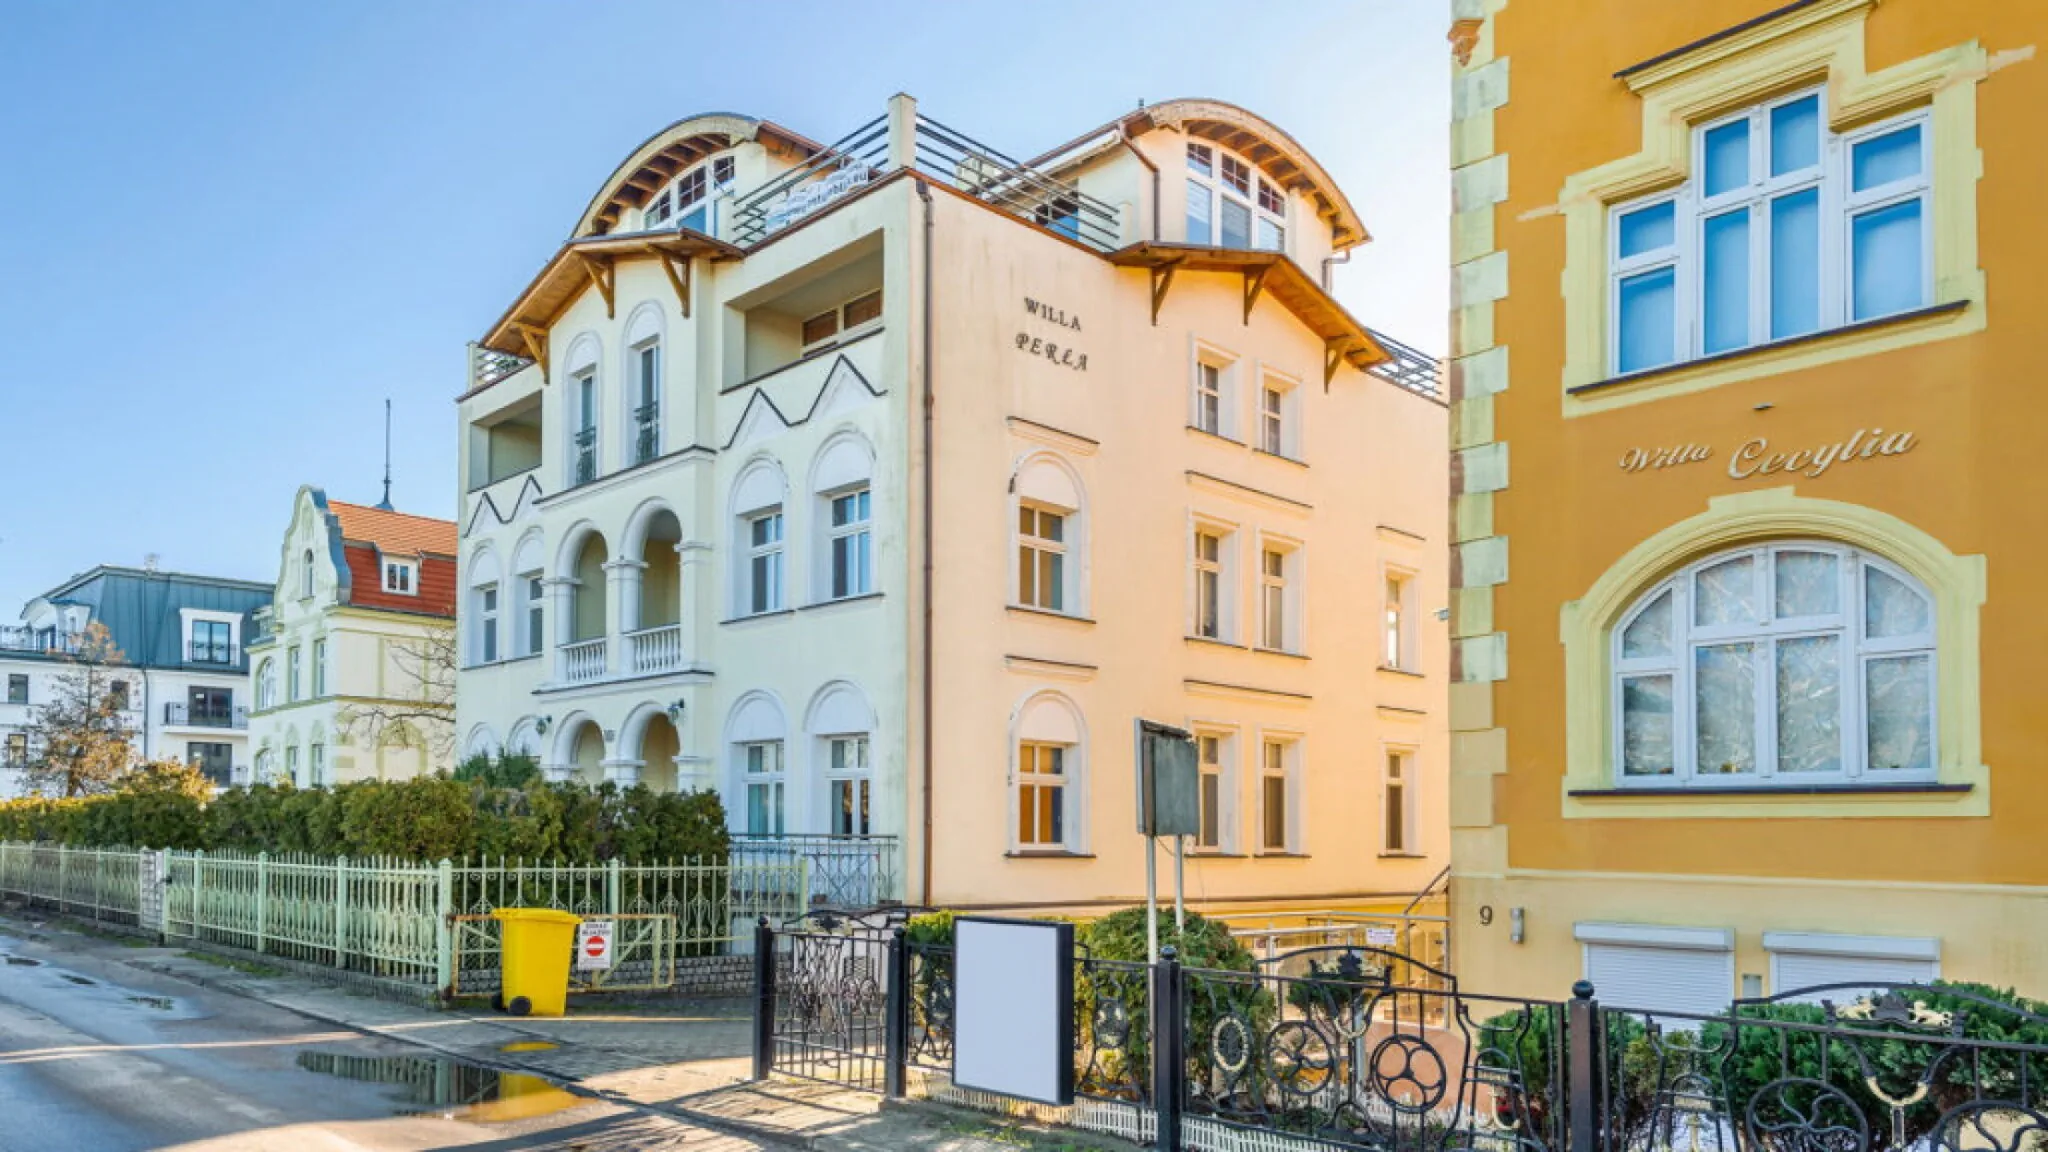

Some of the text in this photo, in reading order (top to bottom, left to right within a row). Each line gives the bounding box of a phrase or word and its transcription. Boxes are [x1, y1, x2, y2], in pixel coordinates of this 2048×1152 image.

[1023, 296, 1081, 331] WILLA
[1618, 427, 1918, 479] Willa Cecylia
[1480, 905, 1493, 926] 9
